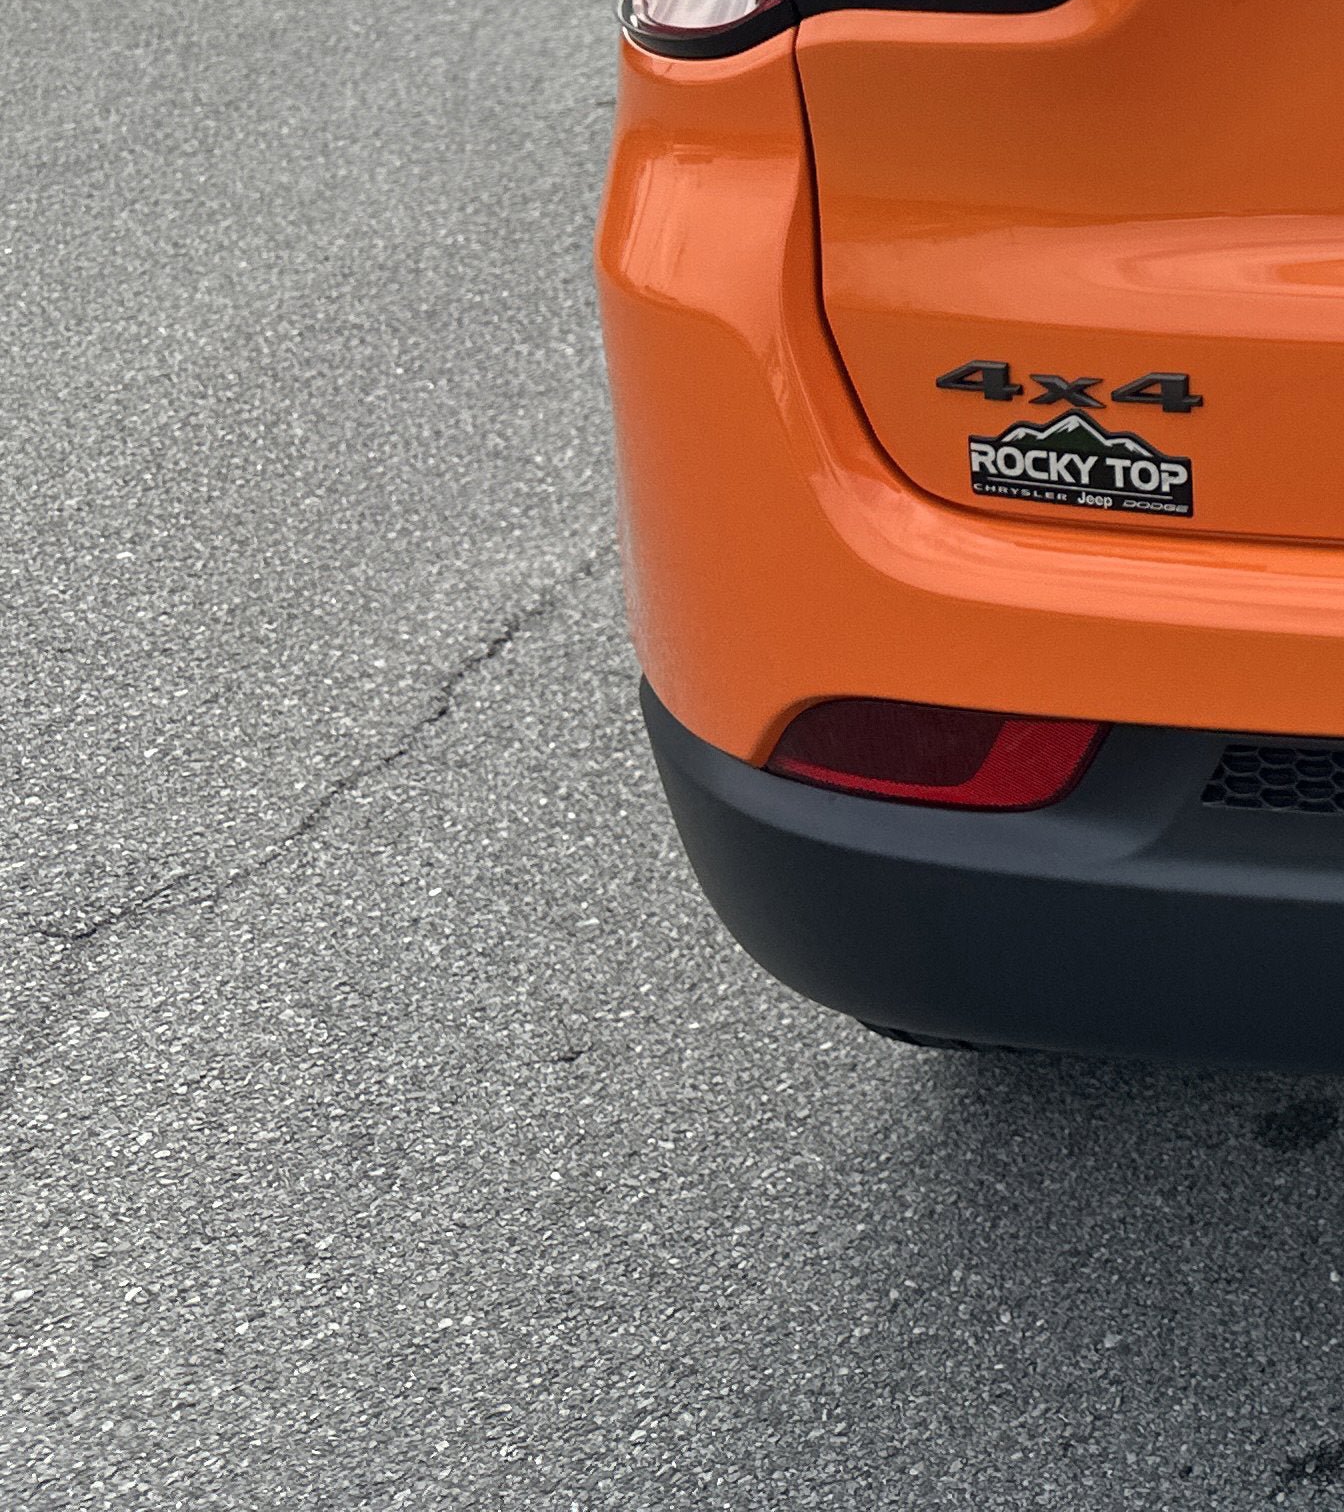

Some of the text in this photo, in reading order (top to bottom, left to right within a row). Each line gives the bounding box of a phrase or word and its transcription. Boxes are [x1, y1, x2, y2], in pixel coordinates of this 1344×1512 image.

[936, 360, 1203, 413] 4x4
[970, 443, 1188, 492] ROCKY TOP
[973, 484, 1188, 513] CHRYSLER Jeep DODGE
